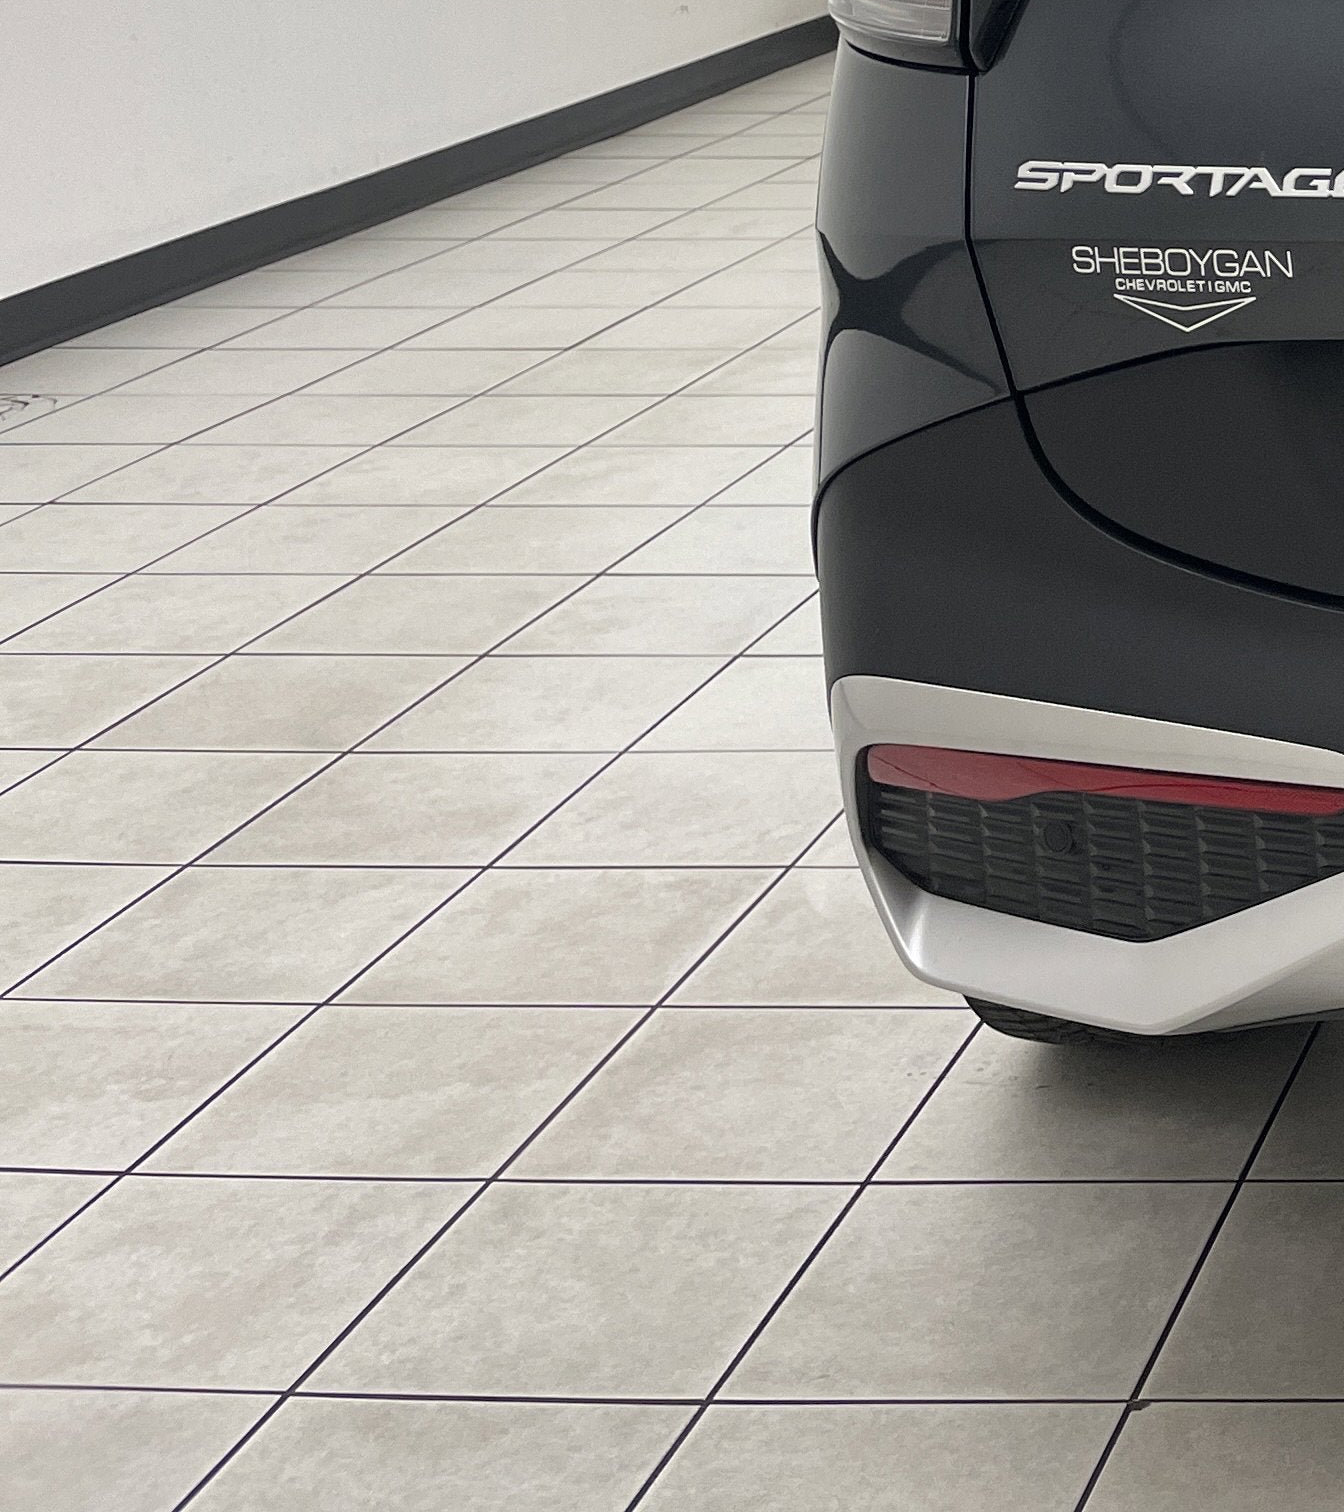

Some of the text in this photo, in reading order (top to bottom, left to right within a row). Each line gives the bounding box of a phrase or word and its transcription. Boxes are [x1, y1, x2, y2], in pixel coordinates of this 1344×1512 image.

[1071, 246, 1294, 278] SHEBOYGAN
[1115, 278, 1252, 294] CHEVROLET GMC
